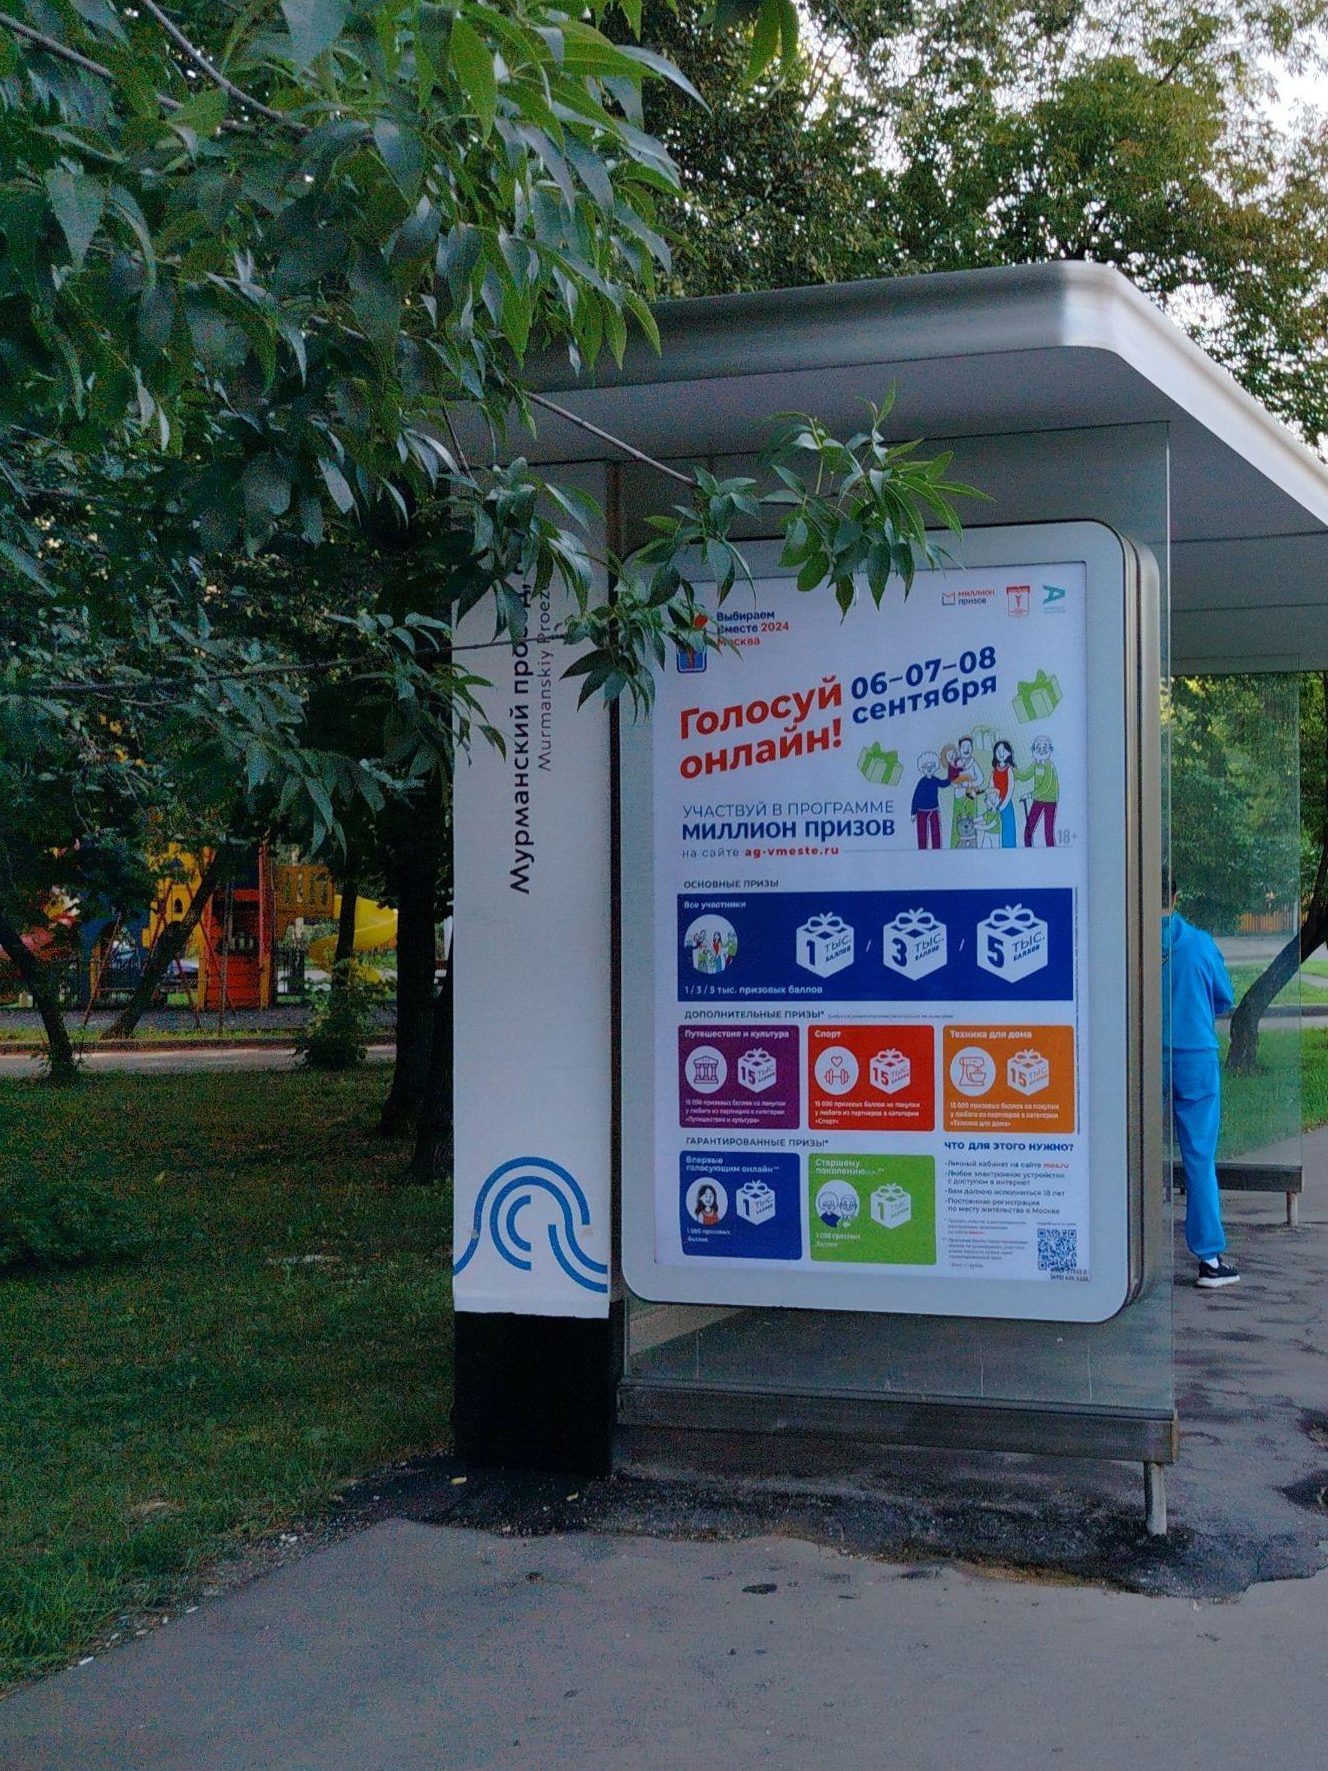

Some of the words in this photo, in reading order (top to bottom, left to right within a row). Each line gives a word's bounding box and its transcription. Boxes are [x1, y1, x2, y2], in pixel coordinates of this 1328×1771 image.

[761, 621, 789, 632] 2024
[680, 675, 842, 740] Голосуй
[852, 675, 997, 724] сентября
[537, 649, 554, 772] Murmanskiy
[680, 718, 842, 779] онлайн!
[509, 704, 534, 894] Мурманский
[683, 801, 767, 818] УЧАСТВУЙ
[772, 804, 783, 816] В
[788, 800, 895, 816] ПРОГРАММЕ
[682, 821, 796, 840] миллион
[805, 819, 895, 842] призов
[1057, 828, 1079, 846] 18+
[682, 850, 697, 859] на
[702, 847, 740, 859] сайте
[745, 846, 840, 860] ag-vmeste.ru
[684, 880, 741, 890] ОСНОВНЫЕ
[743, 879, 779, 889] ПРИЗЫ
[806, 939, 816, 967] 1
[891, 938, 908, 967] 3
[987, 934, 1005, 968] 5
[684, 1011, 782, 1020] ДОПОЛНИТЕЛЬНЫЕ
[814, 1030, 842, 1039] Спорт
[741, 1066, 756, 1085] 15
[873, 1067, 889, 1086] 15
[1010, 1068, 1027, 1087] 15
[686, 1137, 786, 1146] ГАРАНТИРОВАННЫЕ
[944, 1141, 965, 1150] ЧТО
[968, 1142, 990, 1151] ДЛЯ
[993, 1142, 1026, 1151] ЭТОГО
[1028, 1143, 1074, 1152] НУЖНО?
